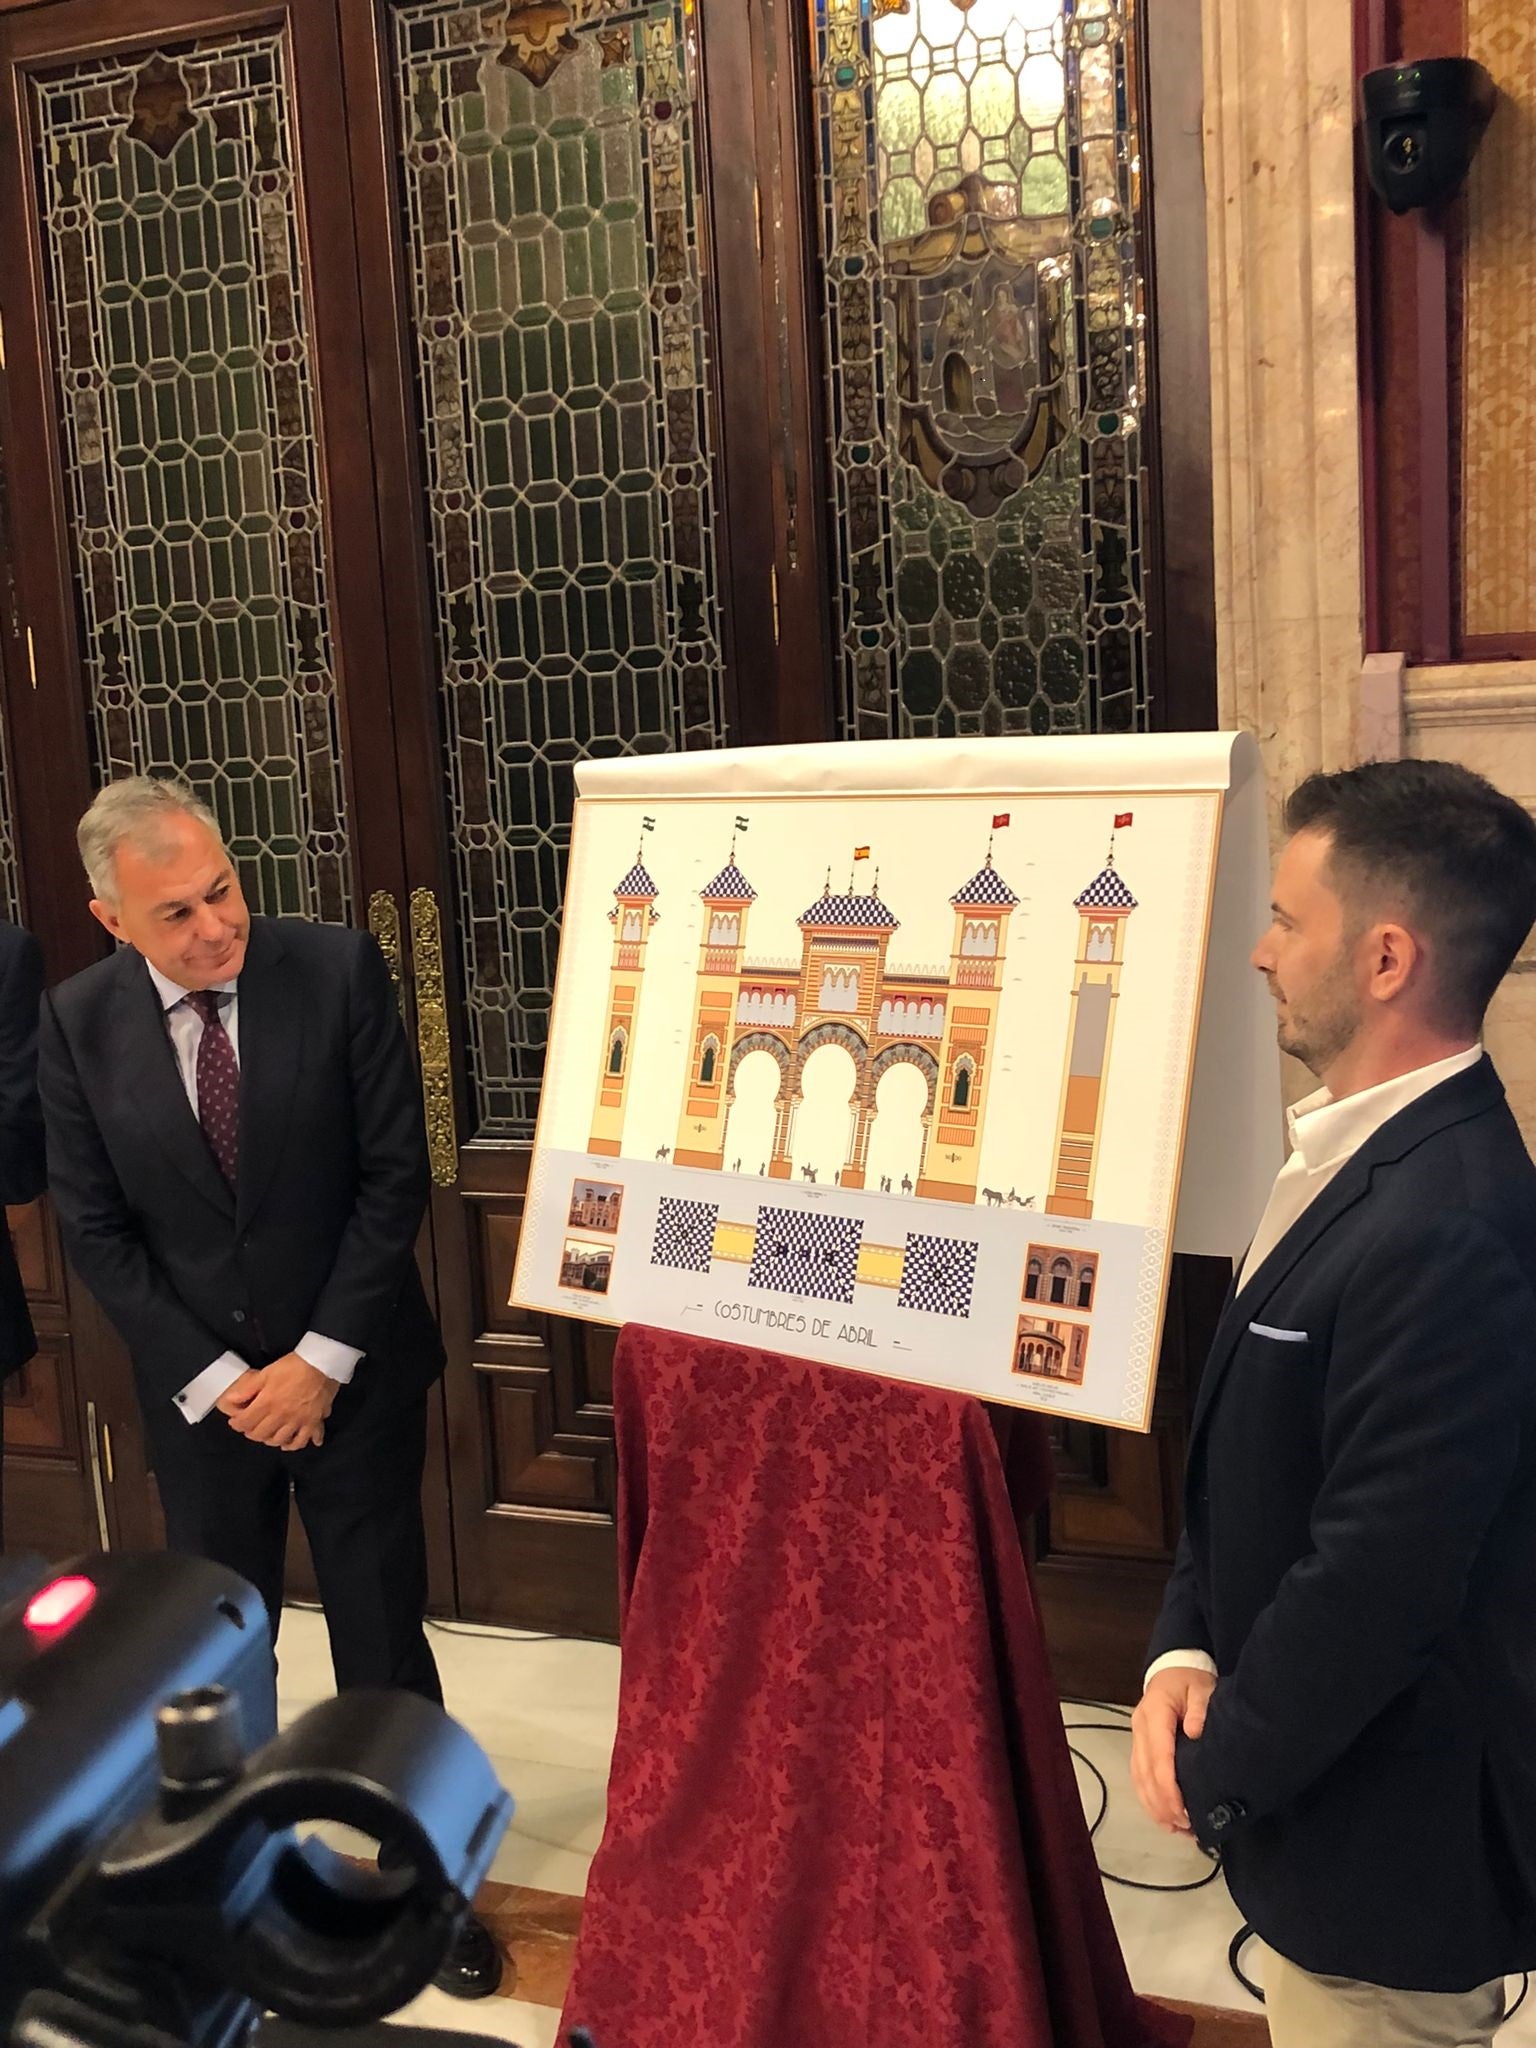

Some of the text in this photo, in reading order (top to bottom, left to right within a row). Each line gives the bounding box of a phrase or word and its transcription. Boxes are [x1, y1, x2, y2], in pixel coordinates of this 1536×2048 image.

[714, 1300, 878, 1348] COSTUMBRES DE ABRIL
